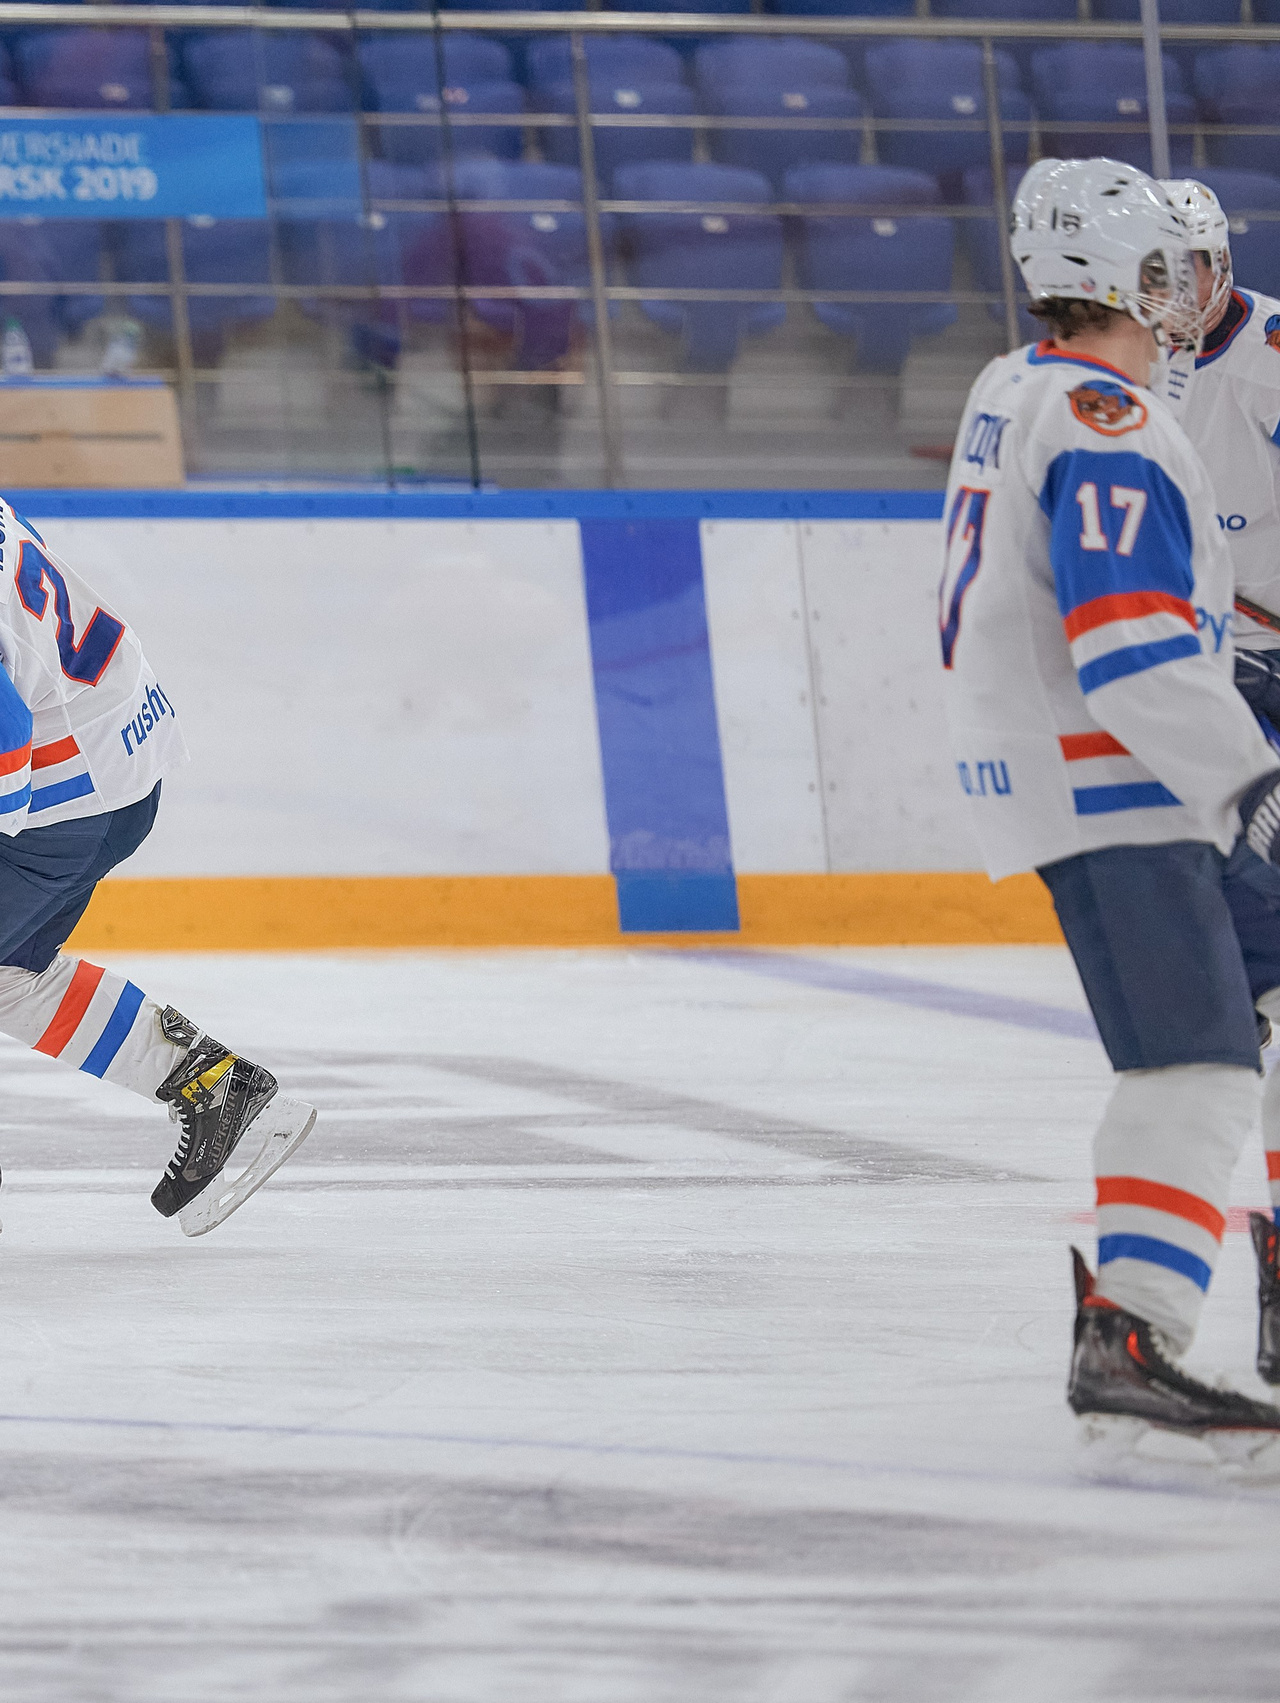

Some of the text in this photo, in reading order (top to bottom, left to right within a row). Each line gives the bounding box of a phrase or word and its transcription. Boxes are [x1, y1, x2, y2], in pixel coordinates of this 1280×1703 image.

[72, 165, 158, 200] 2019
[1075, 482, 1148, 556] 17
[14, 540, 126, 687] 2
